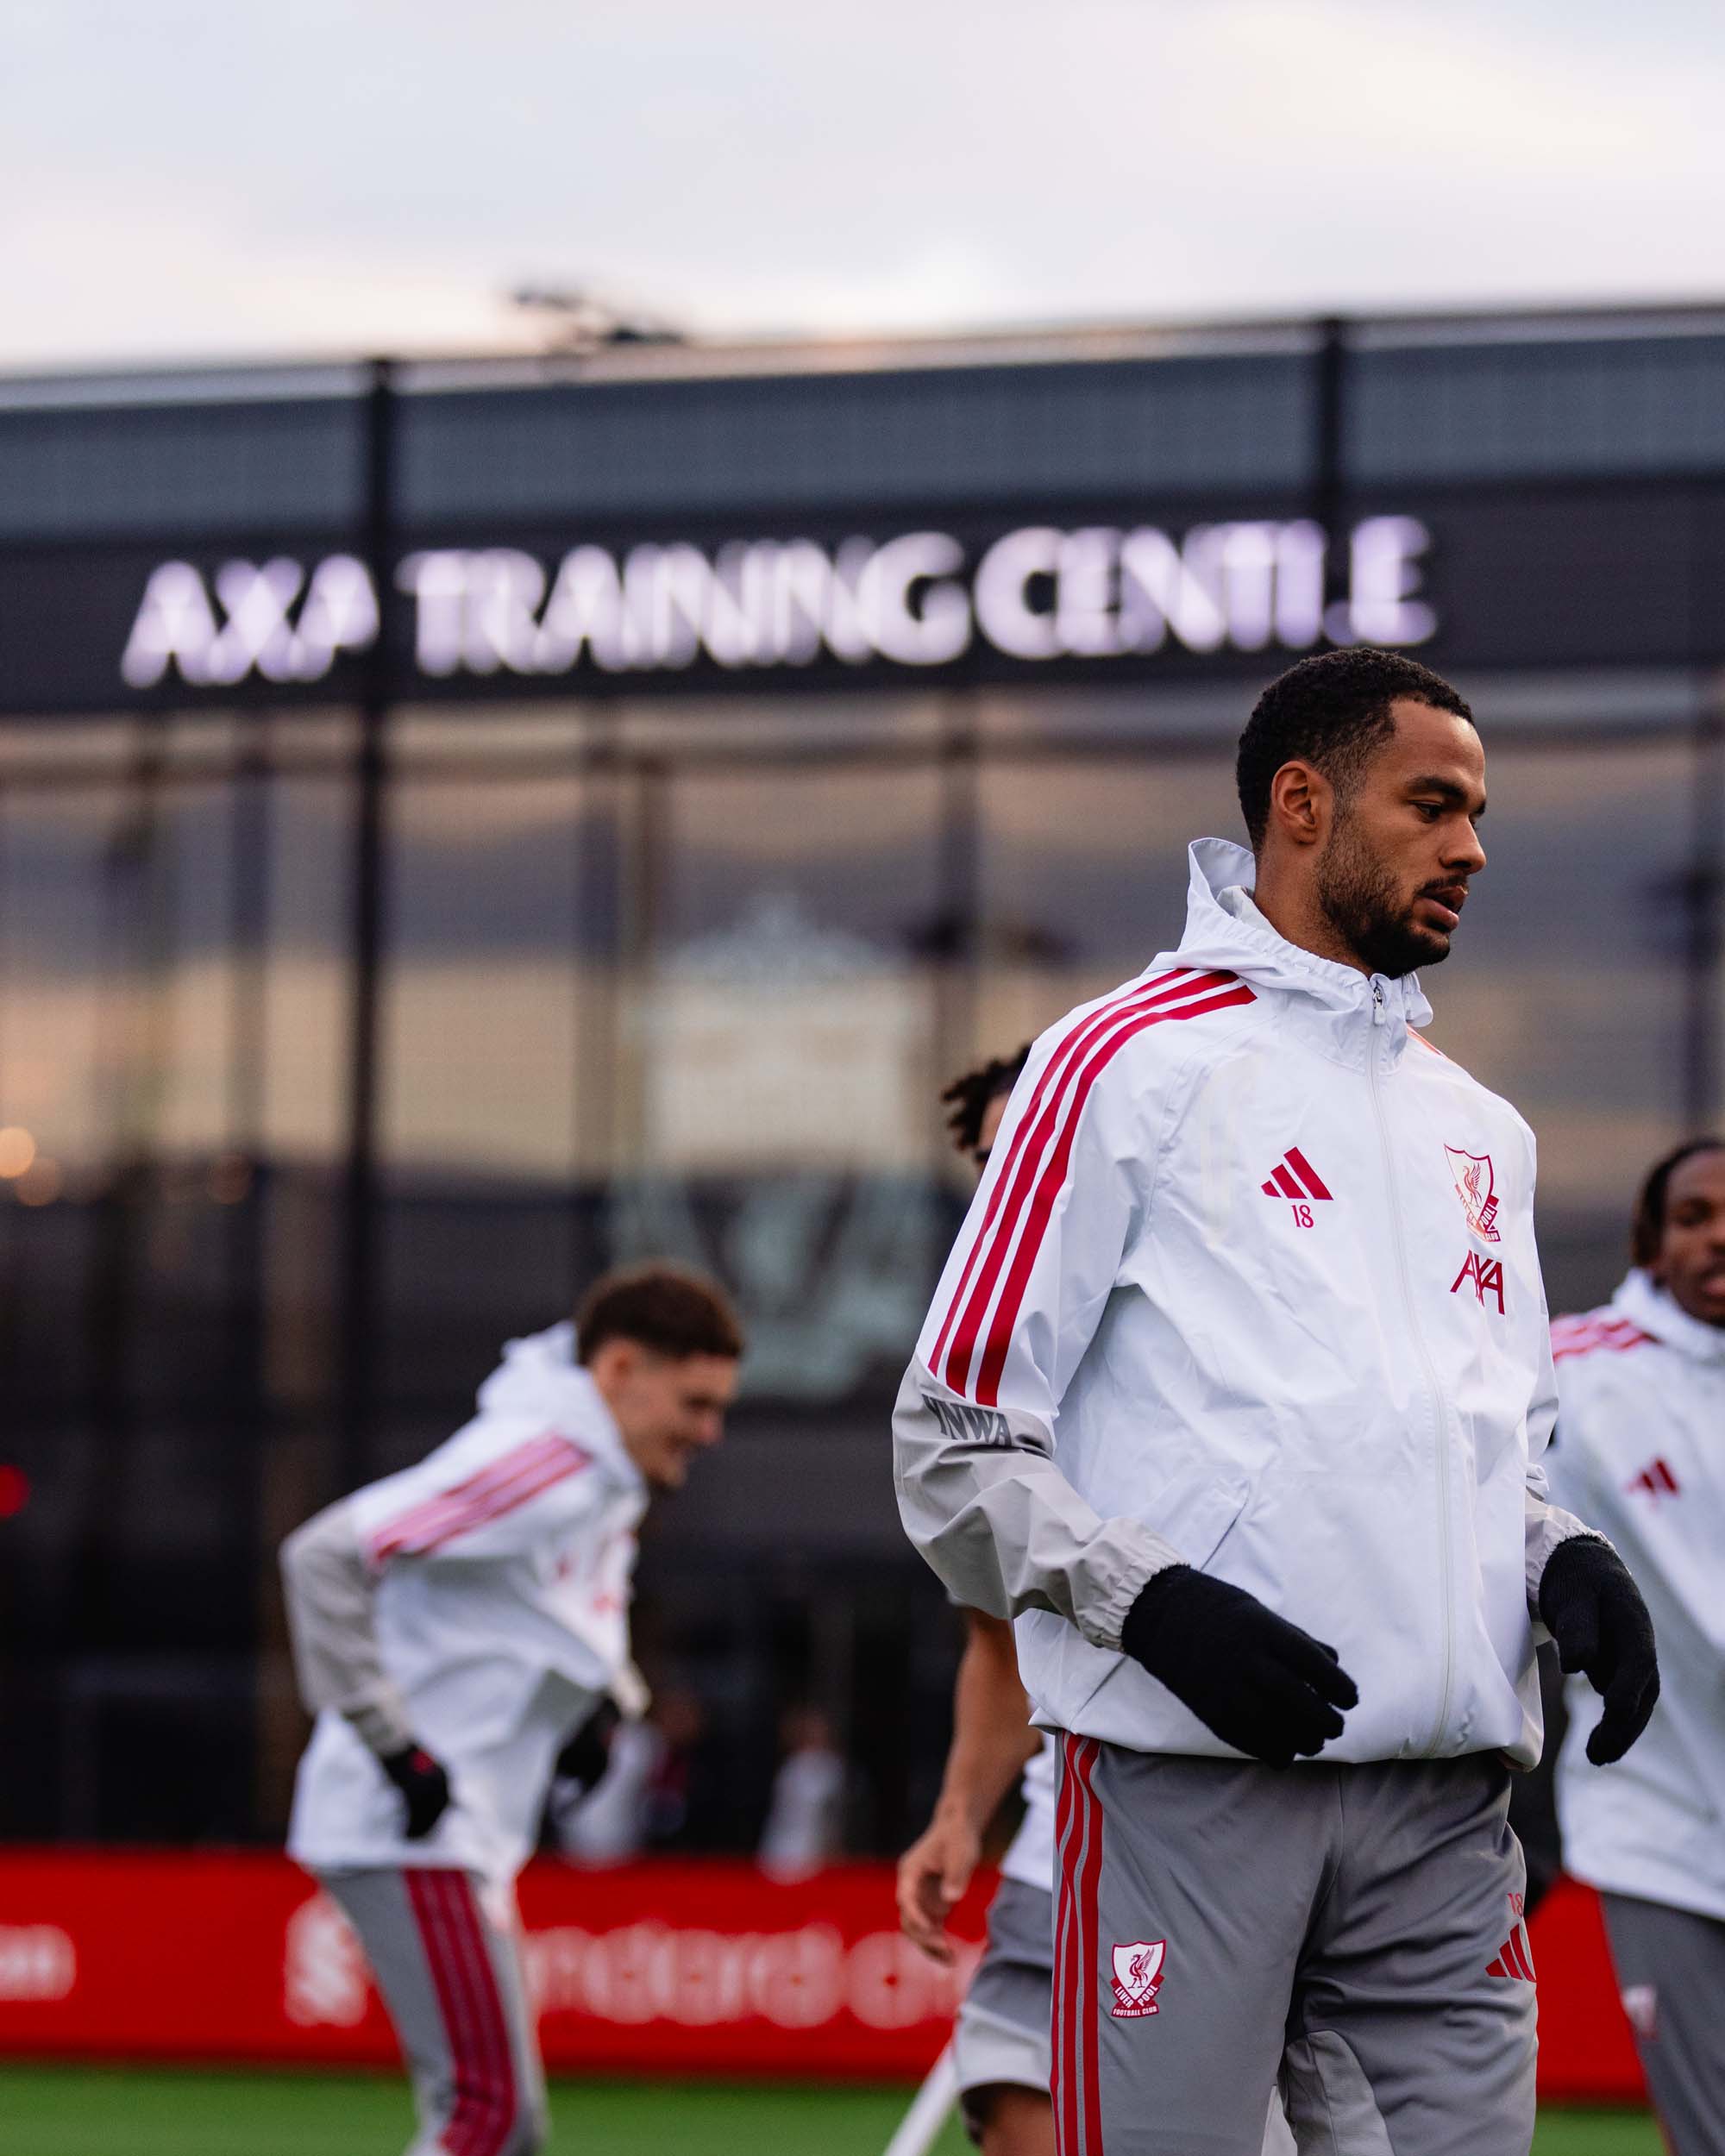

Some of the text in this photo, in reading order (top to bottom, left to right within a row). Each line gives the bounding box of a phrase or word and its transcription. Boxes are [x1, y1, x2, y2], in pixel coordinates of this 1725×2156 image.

[121, 559, 380, 688] AXA
[396, 532, 971, 679] TRAINING
[1291, 1205, 1314, 1228] 18
[921, 1393, 1012, 1446] YNWA
[1507, 1893, 1523, 1918] 18
[1114, 1984, 1158, 2008] LIVER POOL
[1142, 2006, 1157, 2015] CLUB
